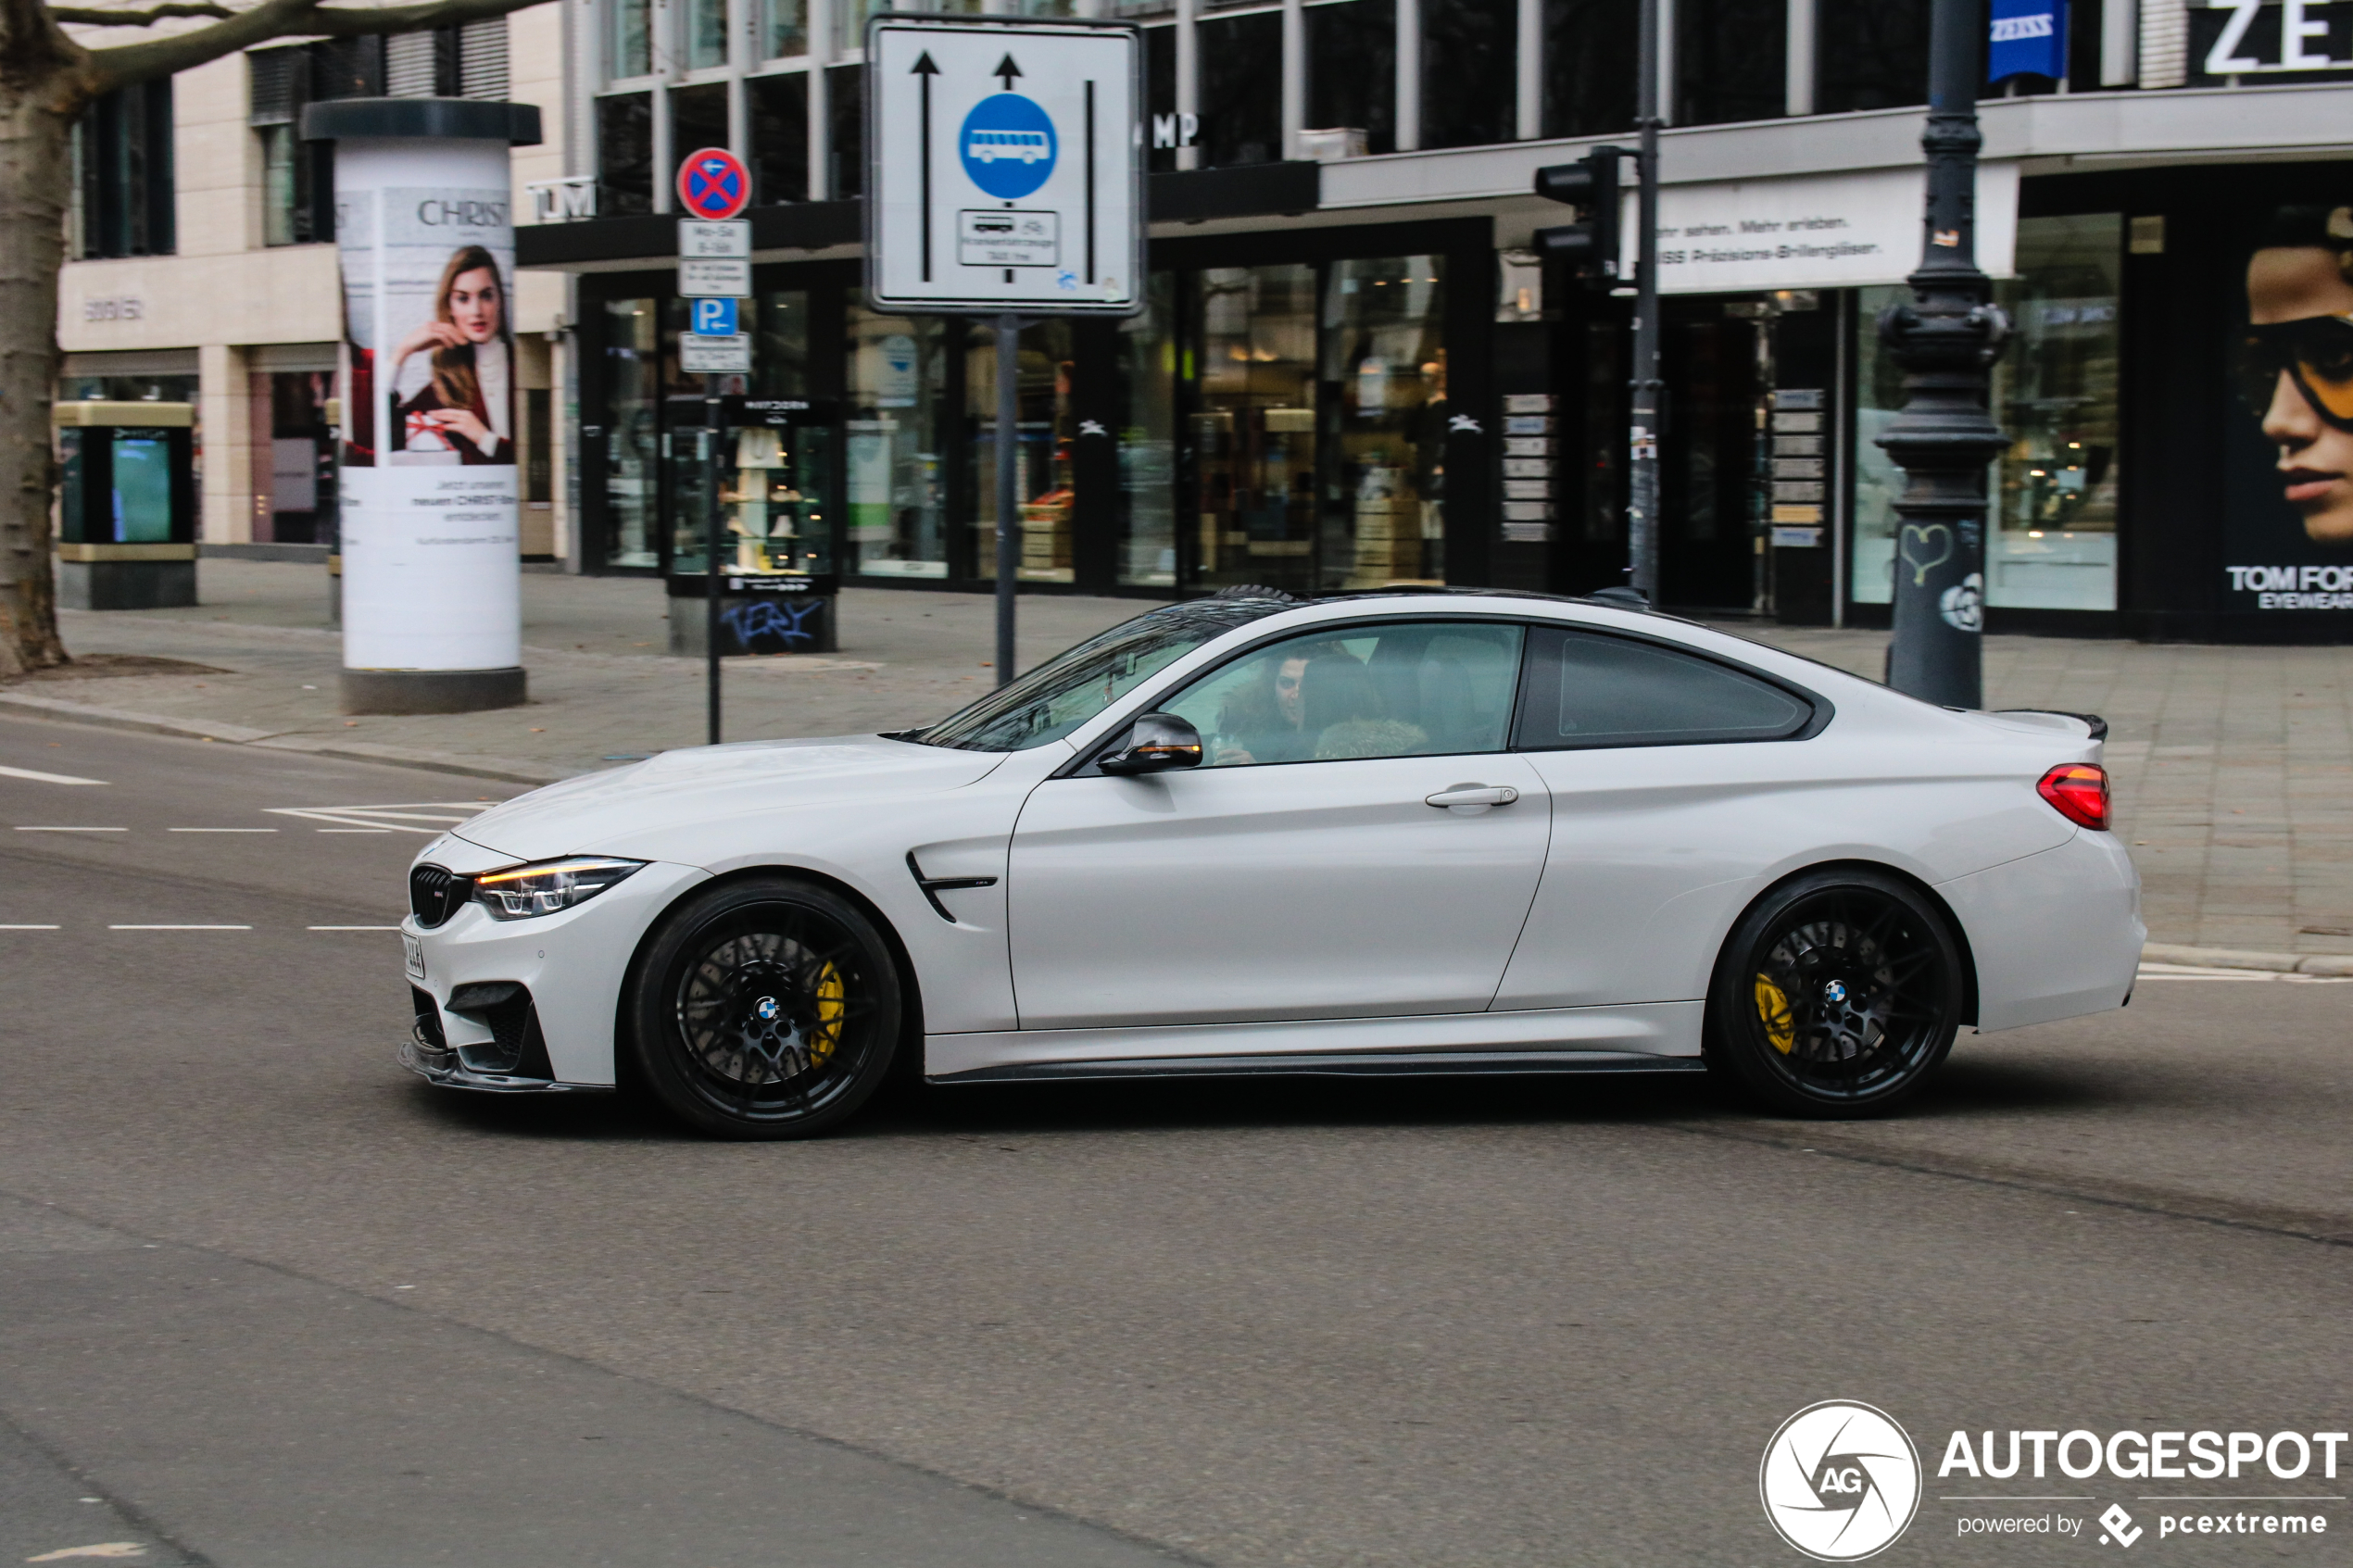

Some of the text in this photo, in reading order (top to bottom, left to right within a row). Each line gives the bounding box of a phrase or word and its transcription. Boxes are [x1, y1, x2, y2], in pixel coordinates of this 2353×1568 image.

[1989, 13, 2054, 42] ZEISS
[2205, 0, 2331, 74] ZE
[418, 199, 509, 228] CHRIST
[1655, 224, 1679, 238] ehr
[1739, 220, 1781, 233] Mehr
[1787, 217, 1849, 232] erleben.
[698, 298, 724, 330] P
[2225, 565, 2297, 591] TOM
